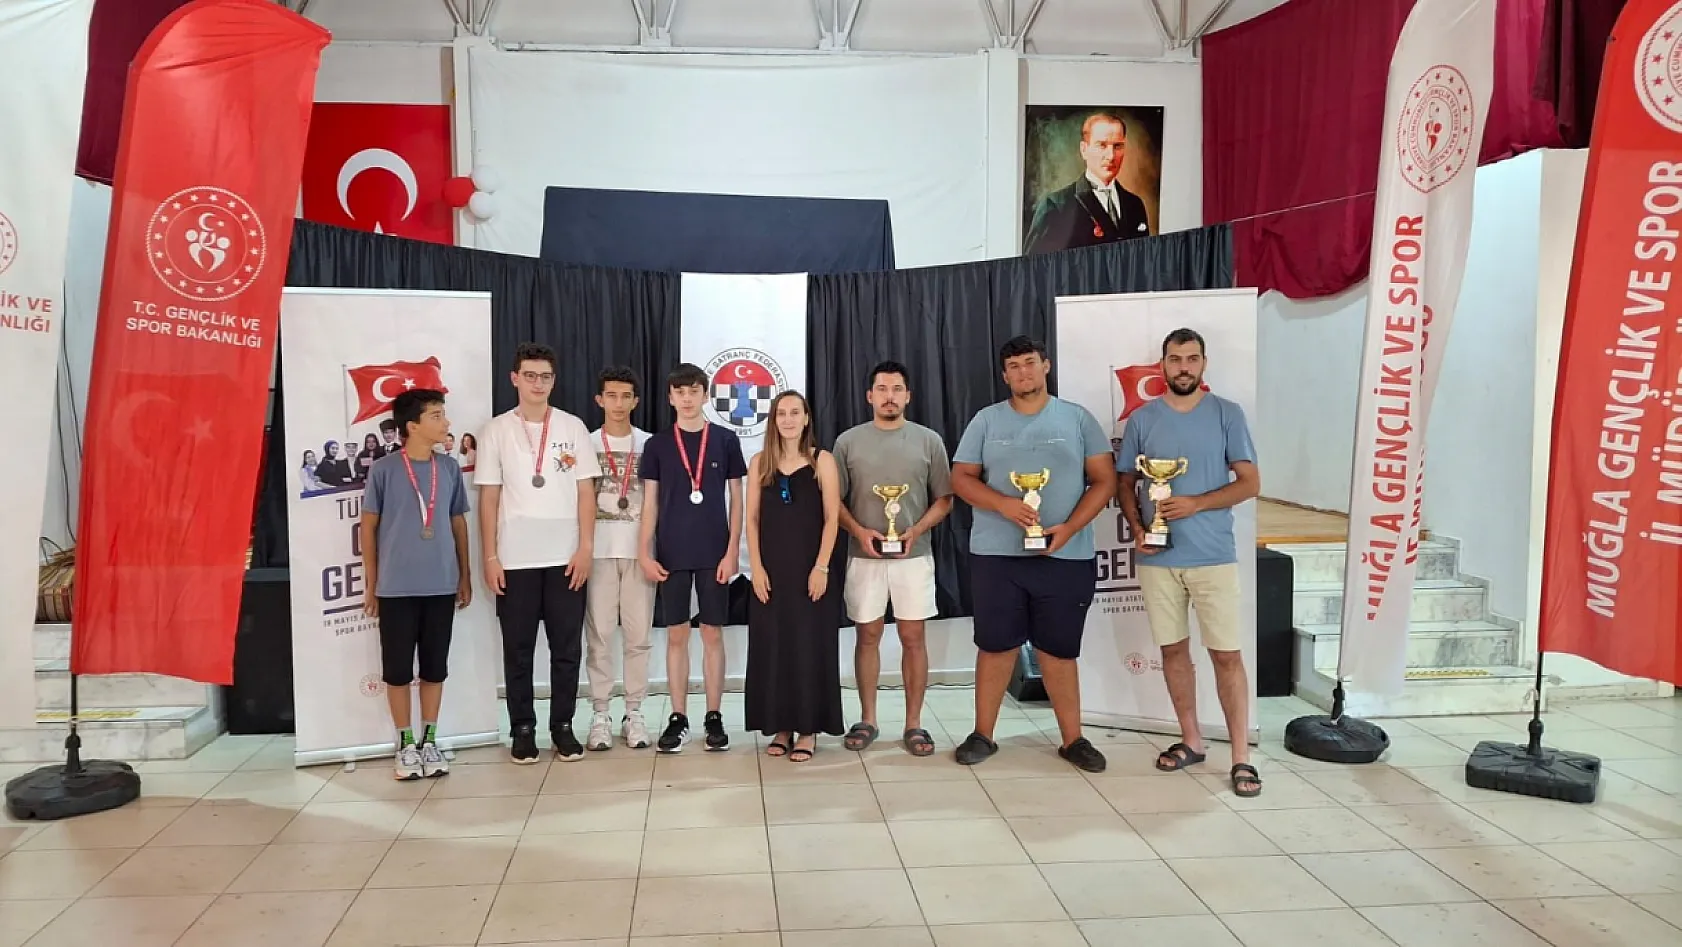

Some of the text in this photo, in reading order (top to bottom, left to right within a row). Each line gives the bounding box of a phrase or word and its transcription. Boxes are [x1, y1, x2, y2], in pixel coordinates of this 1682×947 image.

[1388, 215, 1424, 306] SPOR
[27, 297, 53, 313] VE
[133, 300, 262, 331] T.C. GENÇLİK VE
[1622, 270, 1672, 316] VE
[126, 318, 262, 349] SPOR BAKANLIĞI
[1382, 315, 1416, 356] VE
[1597, 322, 1661, 480] GENÇLİK
[1372, 363, 1414, 503] GENÇLİK
[1581, 490, 1632, 619] MUĞLA
